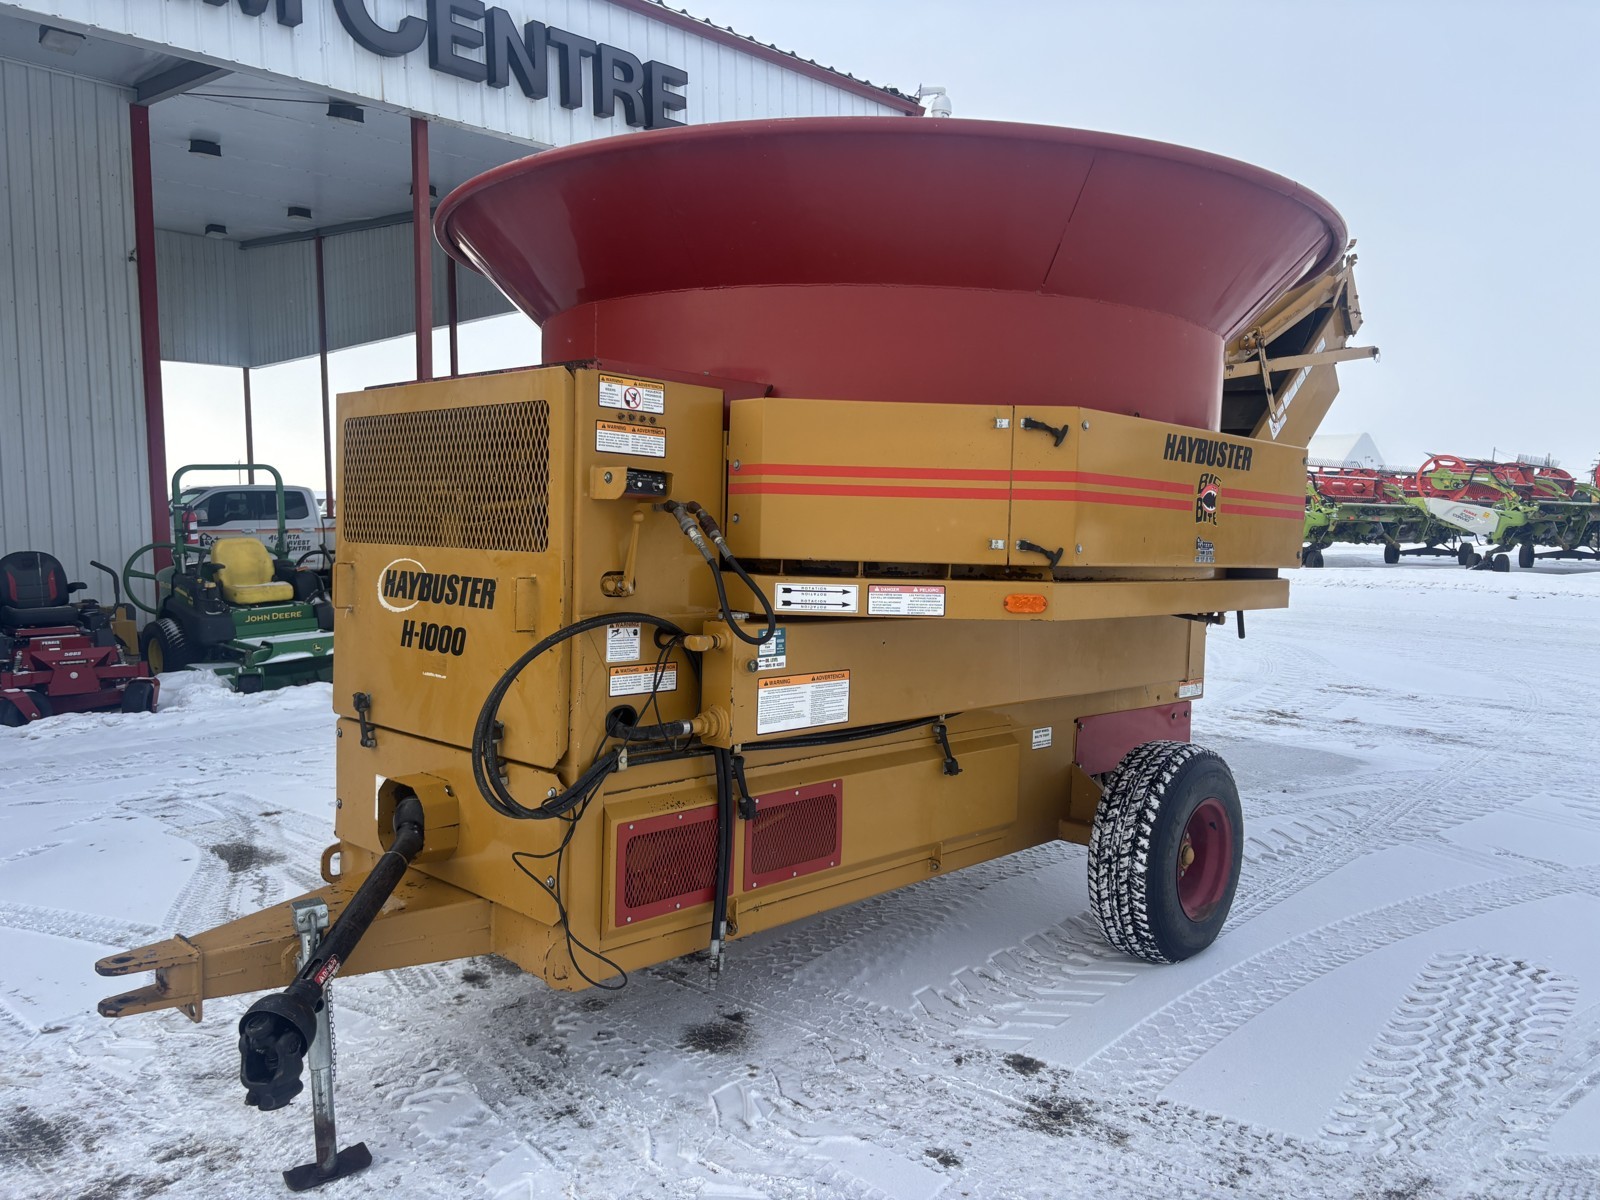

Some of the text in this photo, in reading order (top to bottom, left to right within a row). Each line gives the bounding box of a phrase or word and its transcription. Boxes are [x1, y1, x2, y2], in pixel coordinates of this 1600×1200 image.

[1163, 433, 1253, 471] HAYBUSTER
[384, 570, 496, 609] HAYBUSTER
[245, 611, 302, 623] JOHN DEERE
[401, 619, 466, 656] H-1000
